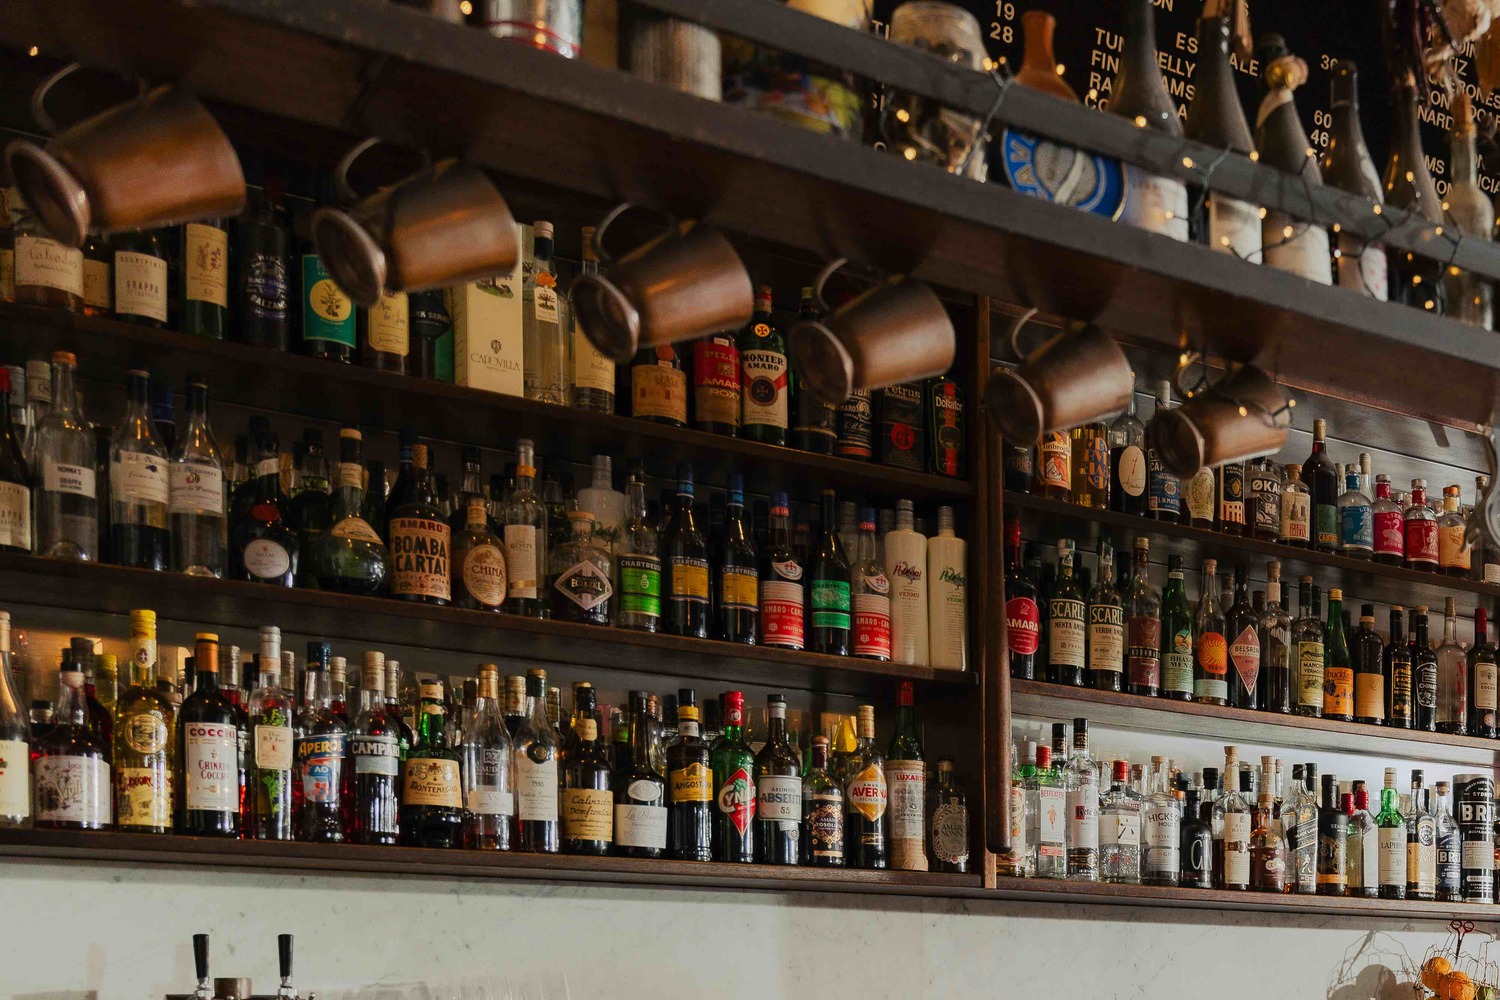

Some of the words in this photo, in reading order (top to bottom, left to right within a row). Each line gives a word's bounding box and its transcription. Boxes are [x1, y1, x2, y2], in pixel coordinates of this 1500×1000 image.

[990, 22, 1014, 44] 28
[1314, 110, 1332, 129] 60
[1310, 129, 1329, 148] 46
[747, 363, 779, 372] AMARO
[400, 520, 443, 533] AMARO
[395, 535, 447, 560] BOMBA
[396, 555, 447, 577] CARTA!
[471, 564, 504, 579] CHINA
[620, 559, 662, 571] CHARTREUSE
[189, 728, 236, 739] COCCHI
[298, 739, 343, 757] APEROL
[352, 741, 401, 756] CAMPARI
[852, 786, 888, 799] AVERNA
[1040, 788, 1065, 798] BEEFEATER
